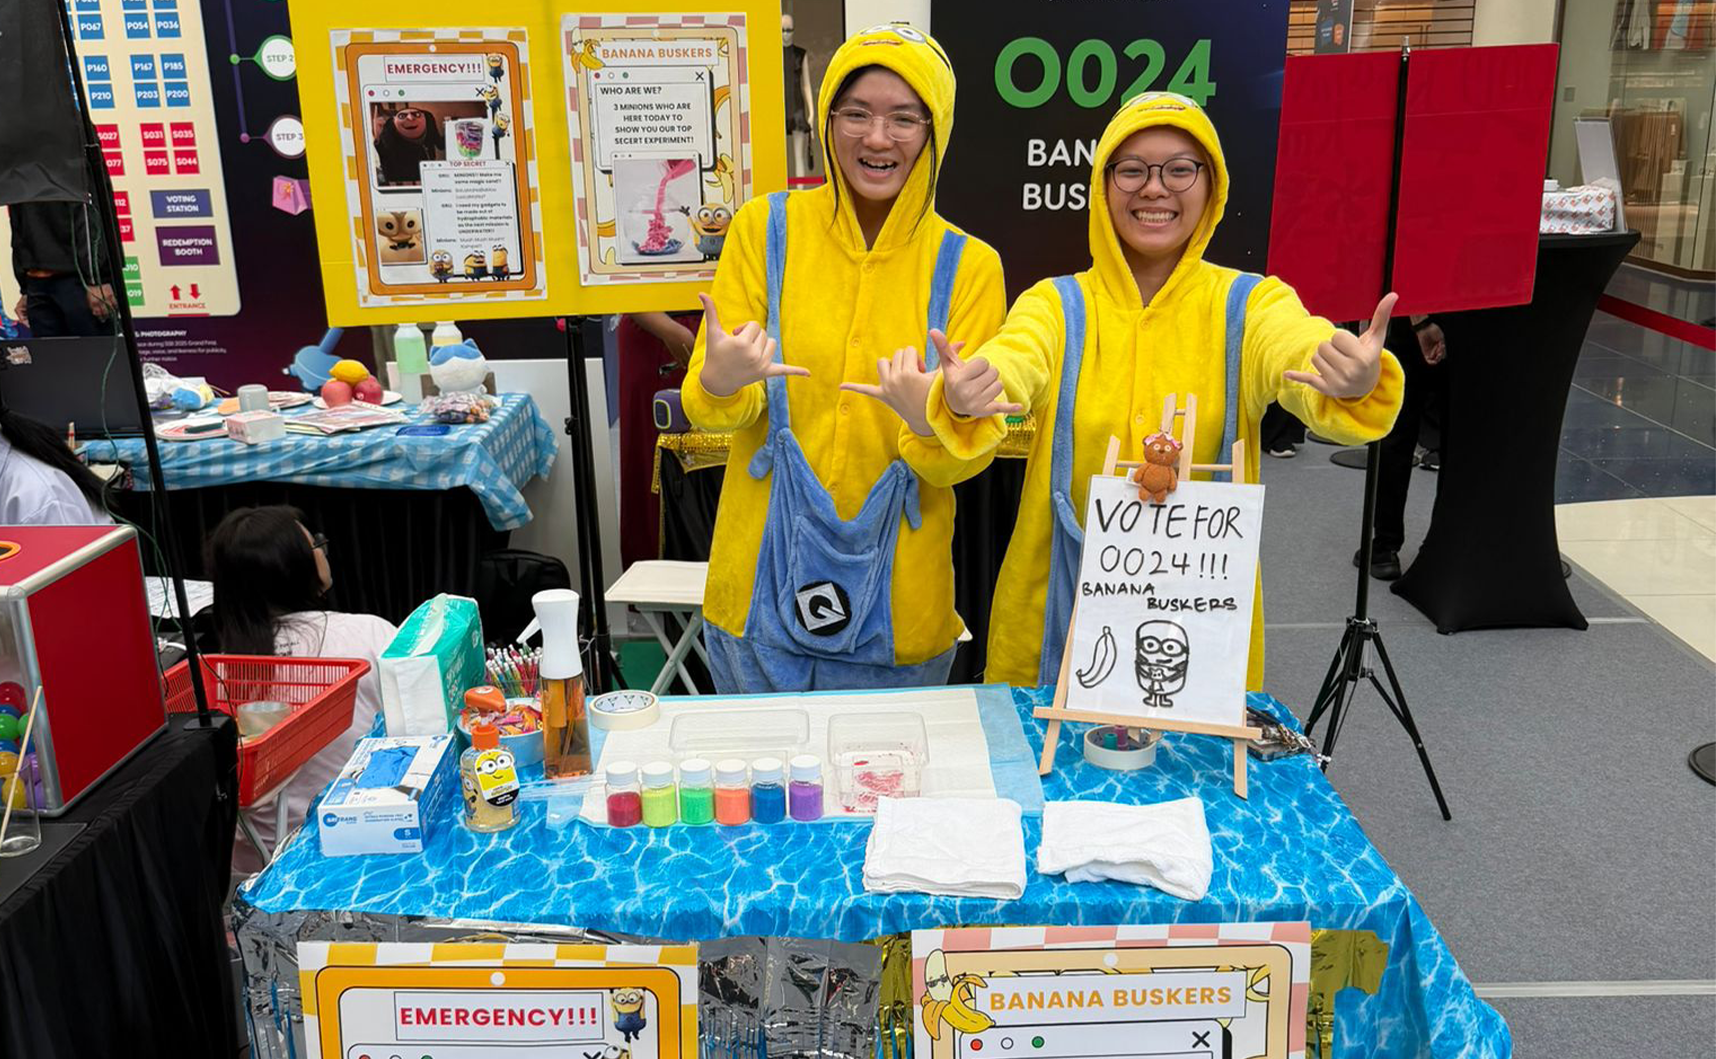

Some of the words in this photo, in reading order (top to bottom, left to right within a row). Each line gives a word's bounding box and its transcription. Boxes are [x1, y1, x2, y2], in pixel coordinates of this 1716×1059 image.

[80, 23, 101, 31] P067
[127, 22, 148, 30] P054
[157, 21, 178, 29] P036
[602, 48, 654, 59] BANANA
[658, 48, 712, 58] BUSKERS
[288, 54, 294, 62] 2
[87, 64, 107, 72] P160
[134, 63, 153, 71] P167
[164, 62, 183, 70] P185
[387, 63, 481, 74] EMERGENCY!!!
[167, 90, 188, 98] P200
[600, 87, 623, 95] WHO
[643, 86, 662, 94] WE?
[91, 92, 111, 100] P210
[137, 91, 158, 99] P203
[143, 131, 163, 139] S031
[172, 130, 193, 139] S035
[276, 133, 297, 141] STEP
[614, 137, 642, 145] SECERT
[644, 136, 694, 144] EXPERIMENT!
[1027, 138, 1096, 167] BAN
[105, 159, 121, 167] 077
[176, 157, 197, 165] S044
[166, 195, 196, 203] VOTING
[162, 238, 213, 247] REDEMPTION
[175, 248, 203, 256] BOOTH
[1095, 498, 1187, 539] VOTE
[1193, 505, 1243, 540] FOR
[1082, 582, 1155, 597] BANANA
[1147, 597, 1237, 612] BUSKERS
[990, 990, 1105, 1012] BANANA
[1113, 986, 1232, 1008] BUSKERS
[400, 1006, 597, 1027] EMERGENCY!!!
